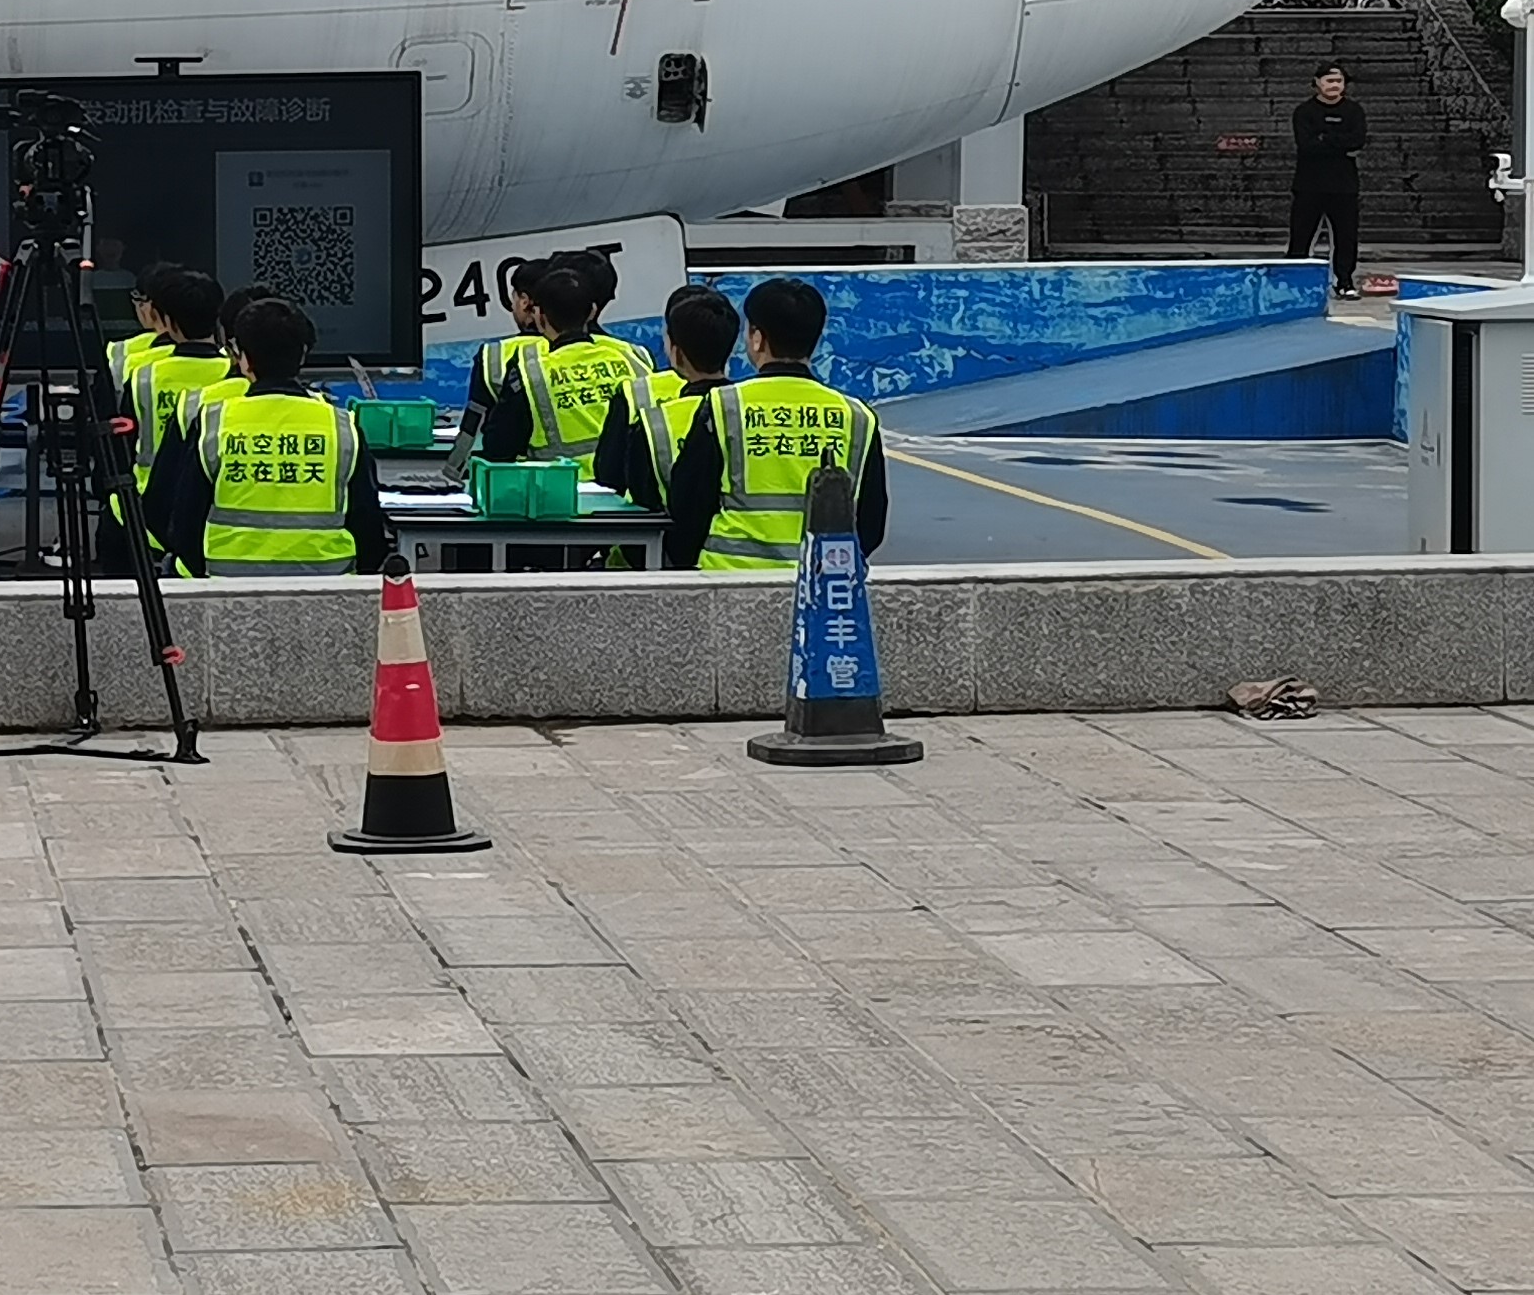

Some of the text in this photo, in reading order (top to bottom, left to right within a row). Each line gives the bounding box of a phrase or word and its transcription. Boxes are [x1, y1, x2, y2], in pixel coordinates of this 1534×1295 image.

[549, 360, 631, 387] 航空报国
[554, 384, 615, 409] 志在蓝
[745, 406, 844, 429] 航空报国
[224, 433, 326, 456] 航空报国
[746, 433, 844, 457] 志在蓝天
[224, 460, 326, 484] 志在蓝天
[824, 579, 859, 689] 日丰管
